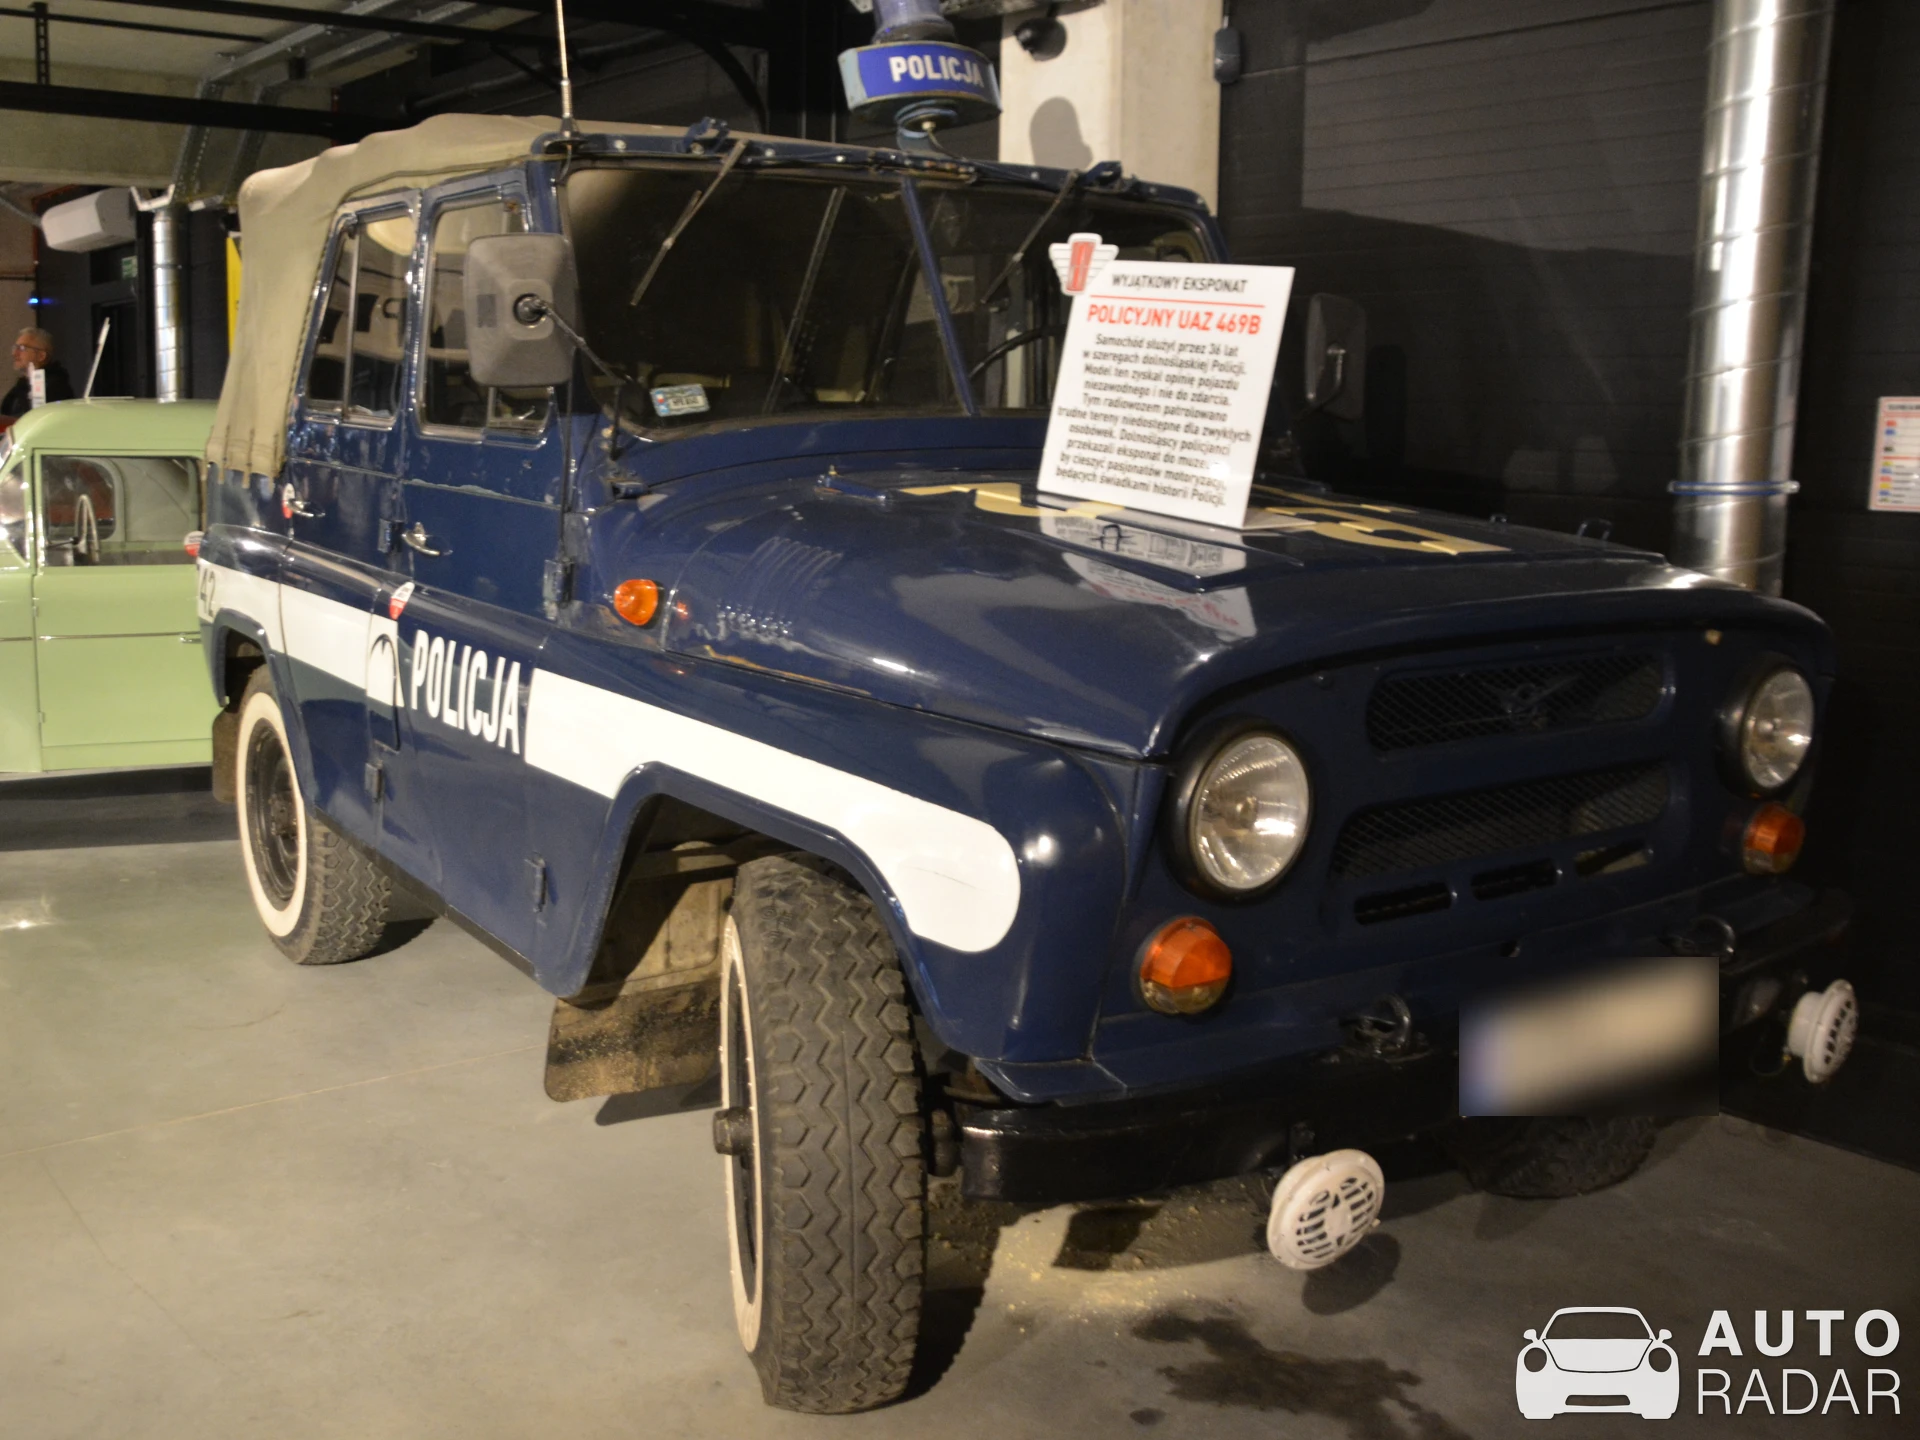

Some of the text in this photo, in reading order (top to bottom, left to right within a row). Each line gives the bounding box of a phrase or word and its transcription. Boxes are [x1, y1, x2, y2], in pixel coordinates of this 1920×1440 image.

[889, 55, 984, 88] POLICJA
[1111, 273, 1248, 293] WYJĄTKOWY EKSPONAT
[1087, 303, 1262, 335] POLICYJNY UAZ 469B
[1178, 342, 1206, 356] przez
[1224, 344, 1239, 357] lat
[1082, 350, 1090, 358] w
[1092, 351, 1140, 365] szeregach
[1211, 360, 1246, 377] Policji.
[1084, 363, 1112, 376] Model
[1114, 367, 1129, 378] ten
[1197, 377, 1240, 391] pojazdu
[1083, 392, 1228, 421] Tym radiowozem patrolowano
[1084, 379, 1151, 398] niezawodnego
[1158, 387, 1173, 400] nie
[1175, 388, 1189, 401] do
[1190, 391, 1231, 407] zdarcia.
[1057, 406, 1087, 419] trudne
[1089, 410, 1119, 426] tereny
[1184, 422, 1200, 435] dla
[1060, 451, 1071, 465] by
[1066, 439, 1114, 454] przekazali
[1117, 446, 1161, 461] eksponat
[1163, 452, 1176, 464] do
[1180, 440, 1230, 456] policjanci
[1152, 482, 1188, 499] historii
[1190, 487, 1227, 508] Policji.
[411, 629, 520, 754] POLICJA
